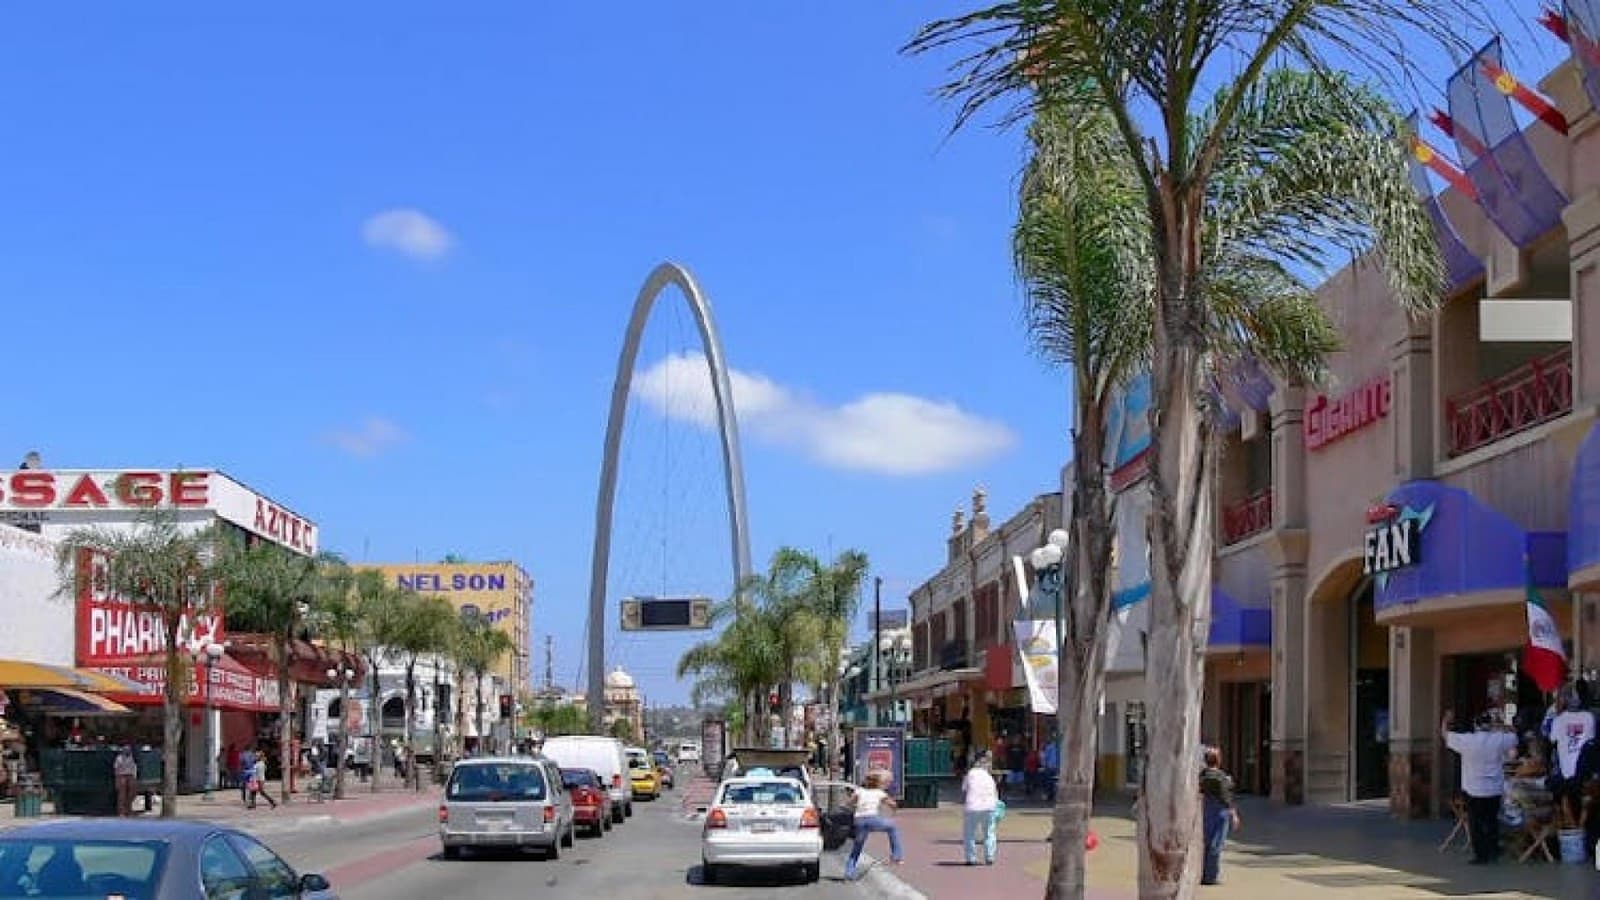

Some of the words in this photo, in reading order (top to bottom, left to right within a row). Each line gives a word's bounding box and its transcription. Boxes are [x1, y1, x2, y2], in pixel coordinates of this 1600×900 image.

[0, 472, 208, 507] SAGE
[254, 498, 313, 556] AZTEC
[1363, 519, 1411, 575] FAN
[399, 573, 505, 591] NELSON
